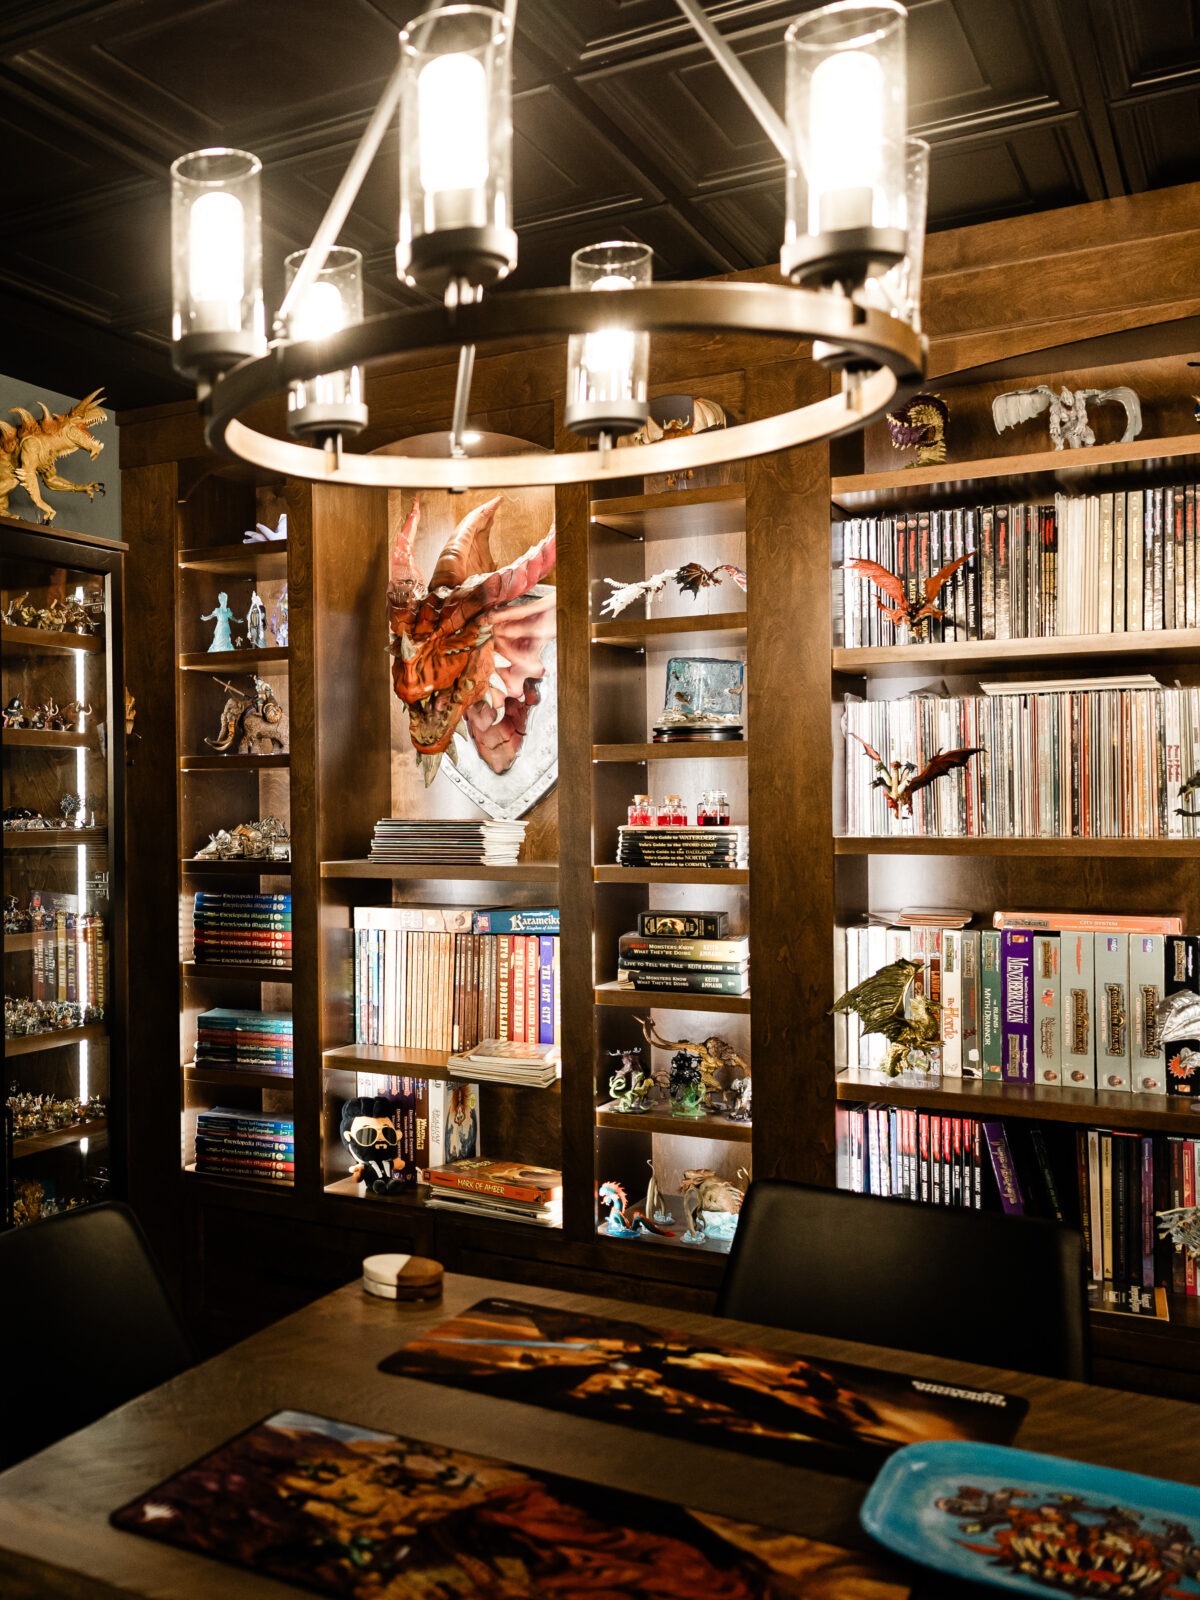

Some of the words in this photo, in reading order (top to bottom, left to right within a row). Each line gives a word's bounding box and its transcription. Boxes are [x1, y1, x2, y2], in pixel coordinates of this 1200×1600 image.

[509, 914, 560, 931] Karameik
[499, 938, 508, 958] INTO
[515, 948, 523, 965] THE
[499, 962, 508, 978] THE
[542, 964, 551, 980] THE
[932, 970, 940, 993] LANDS
[1007, 956, 1029, 1023] MENZOBERRANZAN
[515, 991, 523, 1002] OF
[528, 987, 536, 998] THE
[542, 984, 551, 1002] LOST
[984, 988, 992, 1009] MYTH
[499, 982, 508, 1041] BORDERLANDS
[542, 1006, 551, 1024] CITY
[944, 1006, 959, 1040] Horde
[984, 1010, 992, 1046] DRANNOR
[457, 1178, 474, 1189] MARK
[475, 1182, 483, 1190] OF
[484, 1184, 505, 1194] AMBER
